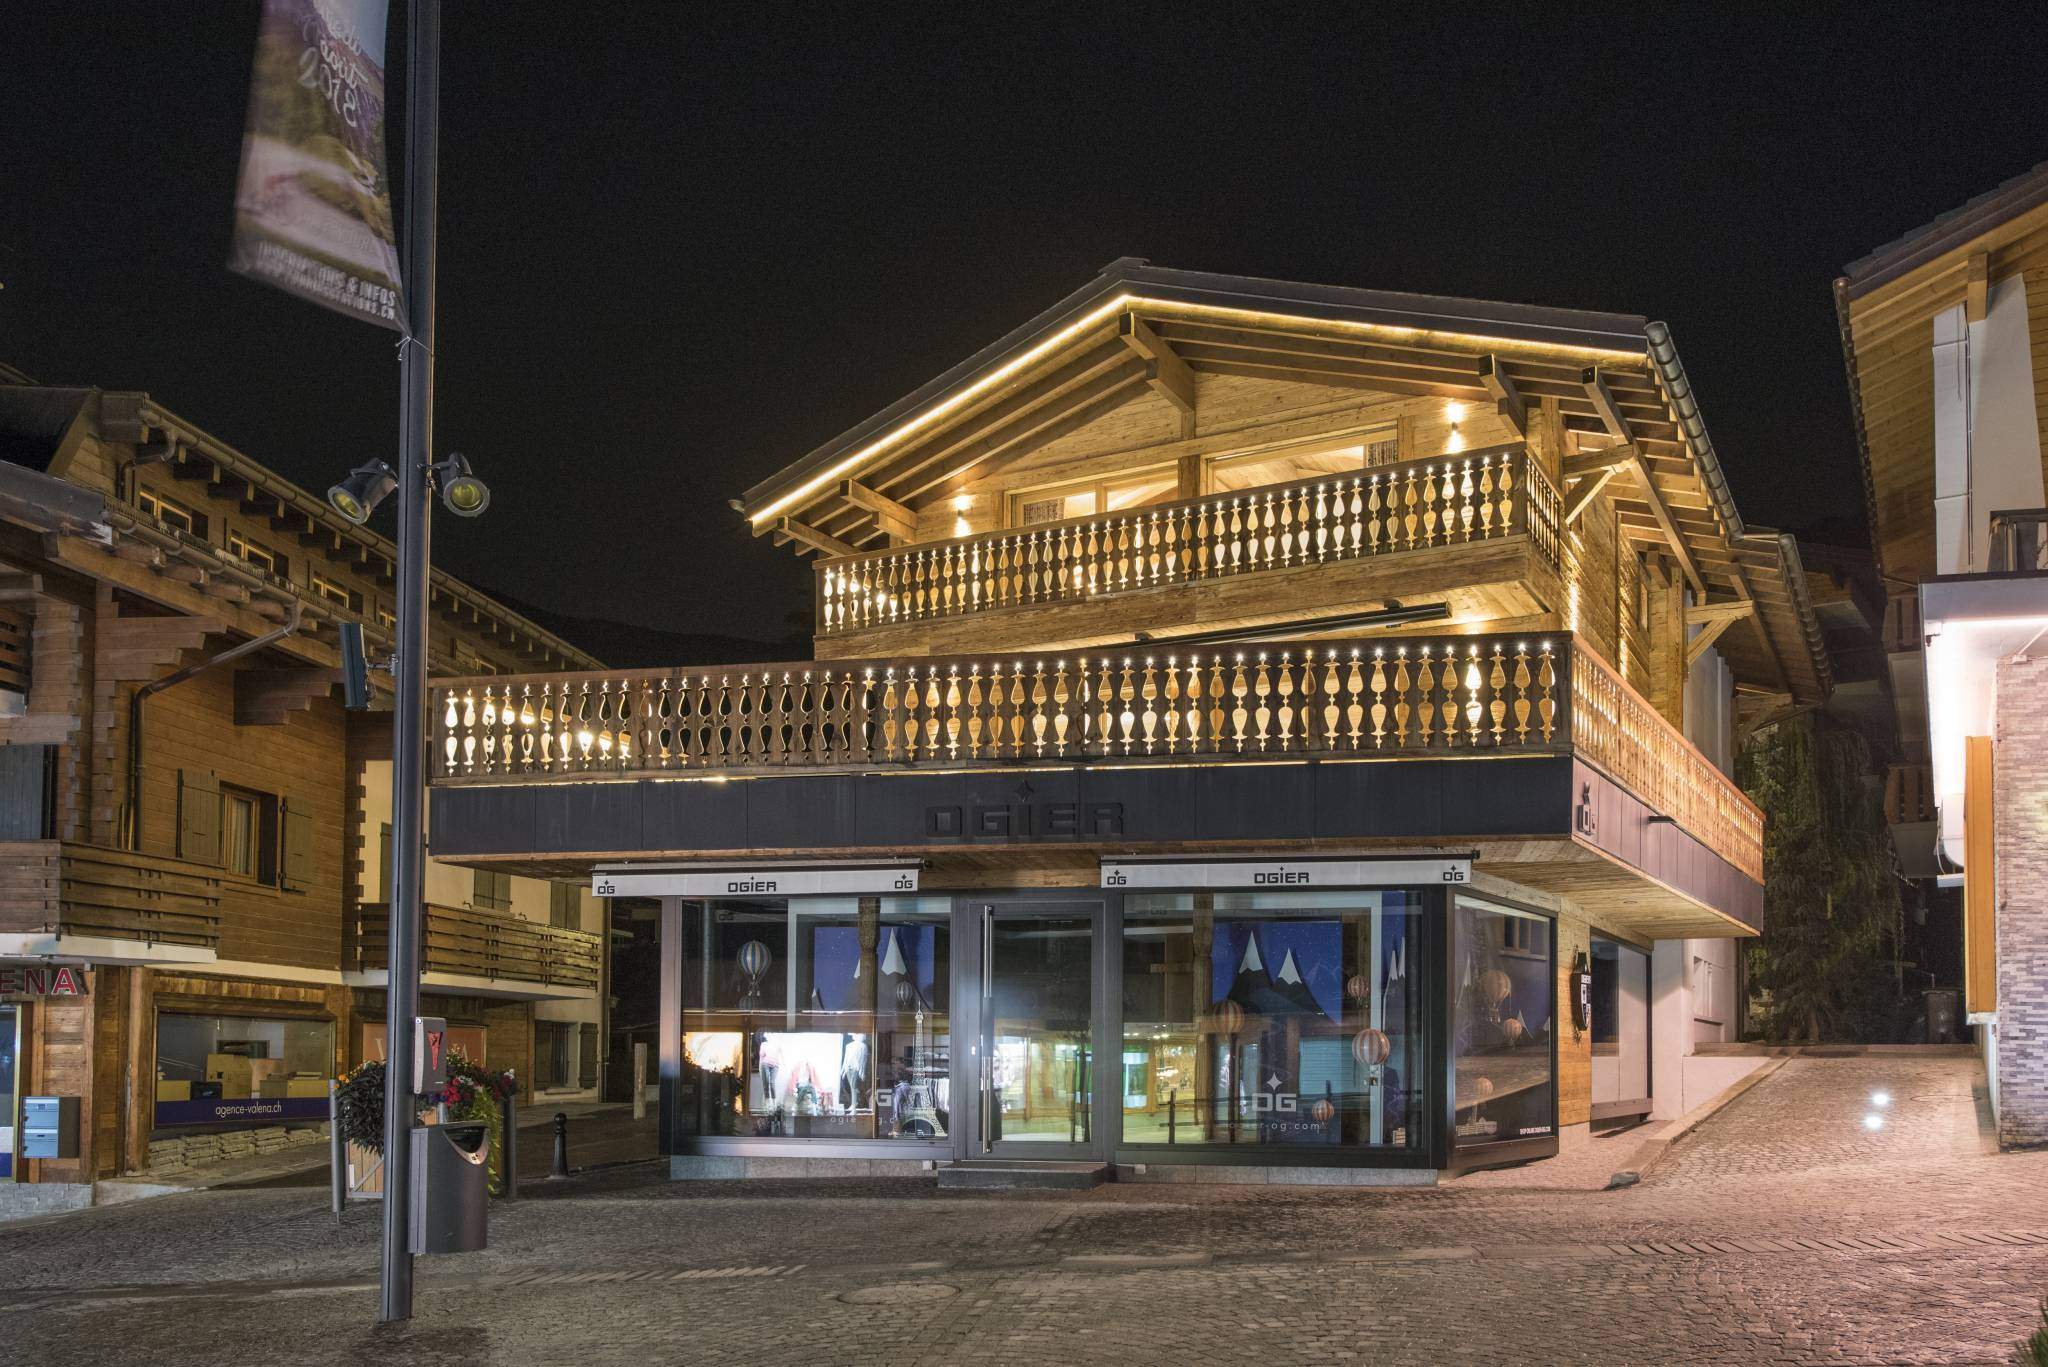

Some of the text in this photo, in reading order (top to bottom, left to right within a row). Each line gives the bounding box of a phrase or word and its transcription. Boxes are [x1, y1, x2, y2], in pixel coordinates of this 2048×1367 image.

[926, 802, 1125, 838] OGIER
[1107, 875, 1127, 886] OG
[1254, 871, 1310, 884] OGIER
[1443, 870, 1464, 882] OG
[597, 884, 616, 895] OG
[728, 880, 777, 893] OGIER
[894, 879, 913, 890] OG
[215, 1099, 282, 1118] agence-valena.ch
[1252, 1092, 1297, 1112] OG
